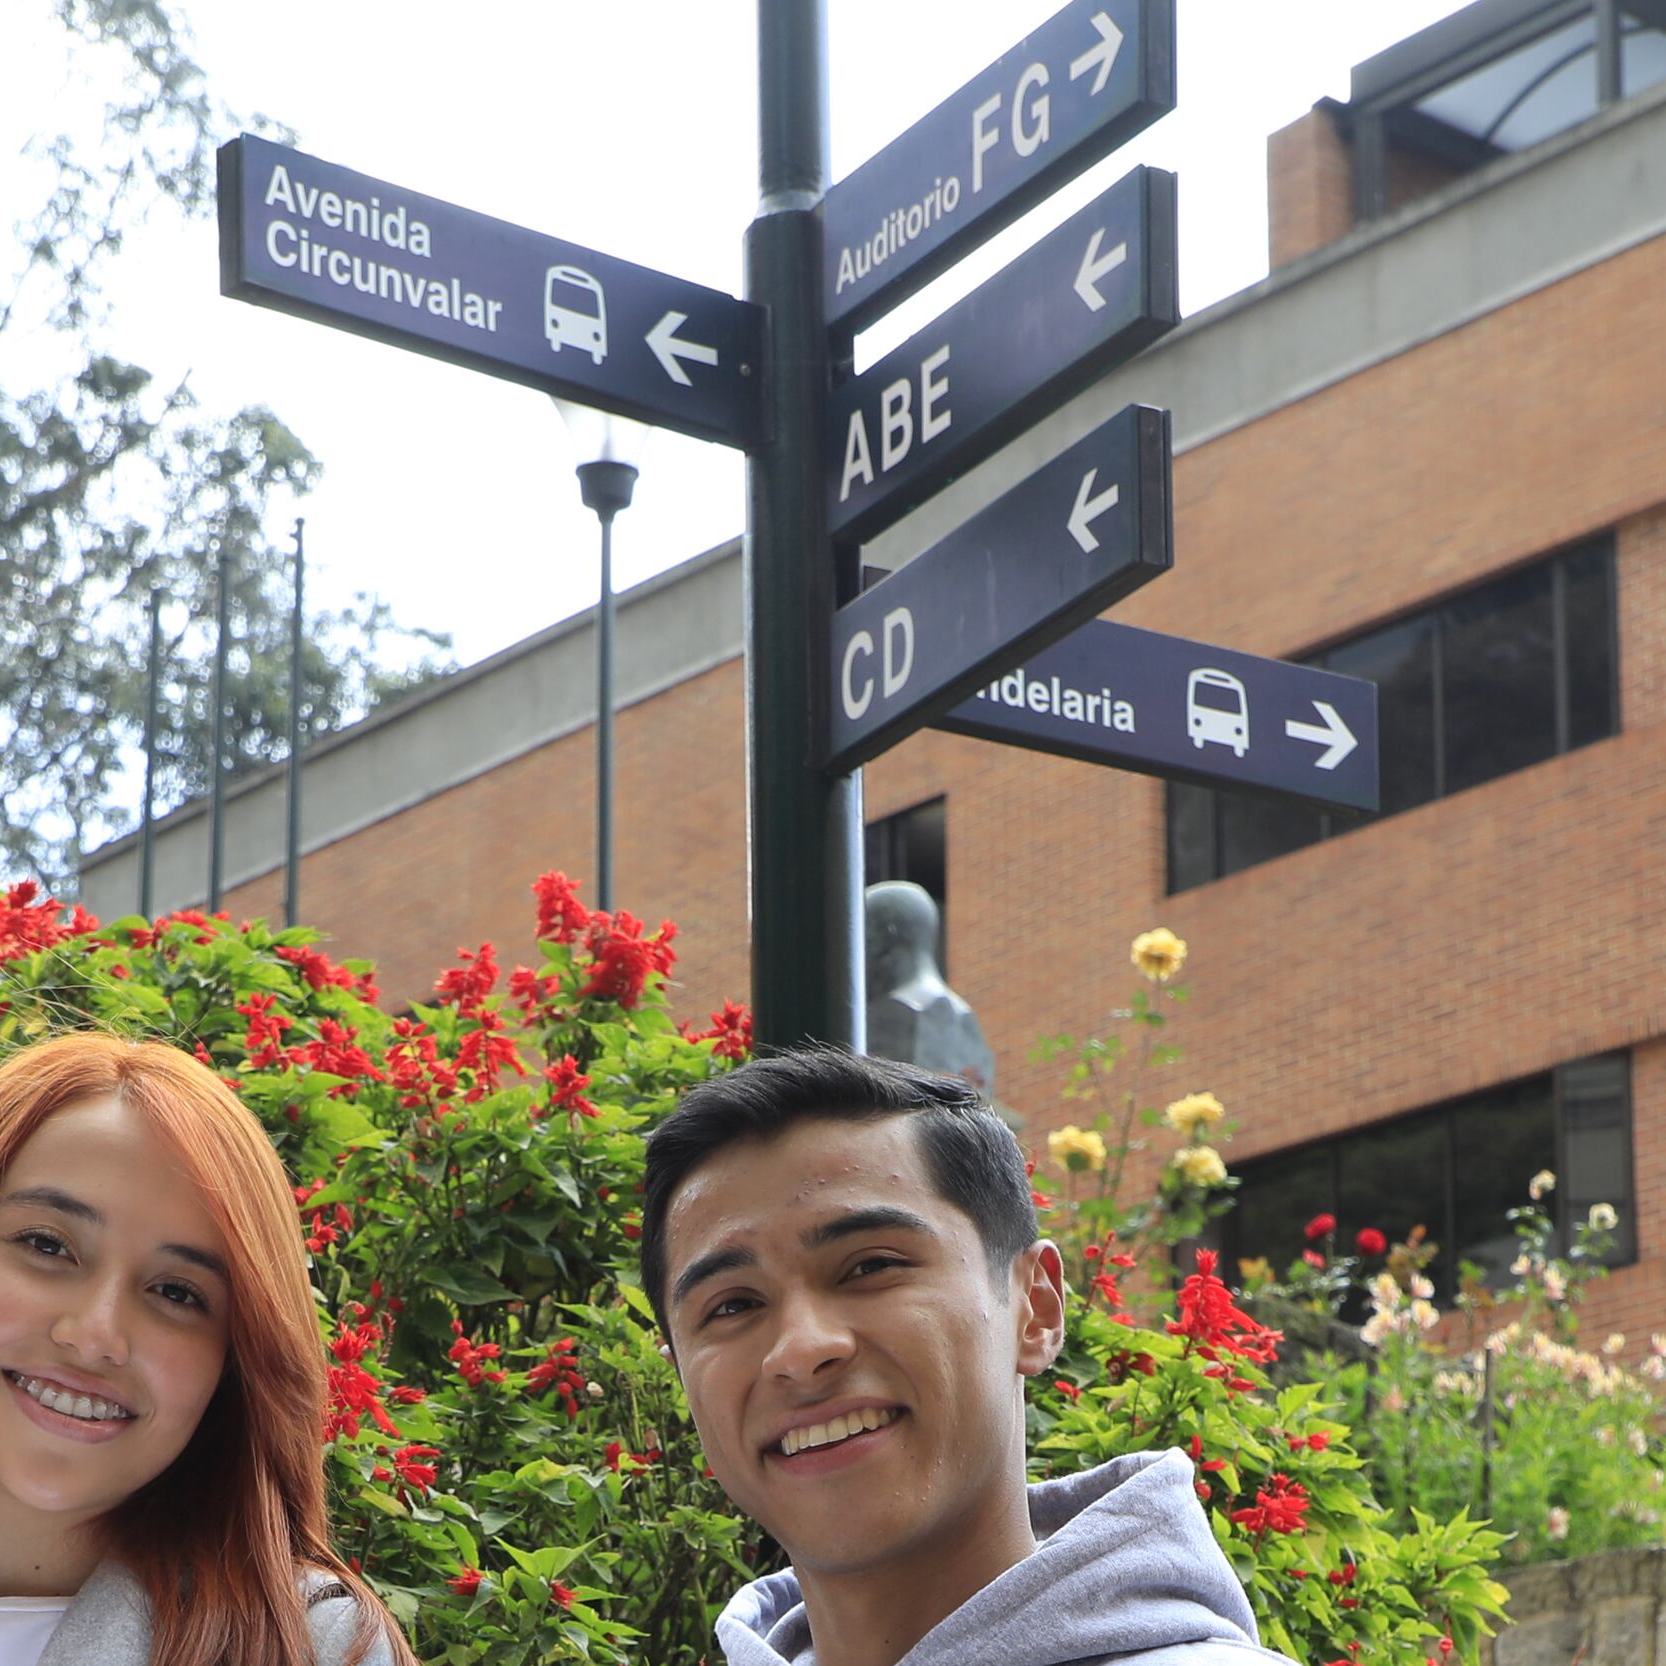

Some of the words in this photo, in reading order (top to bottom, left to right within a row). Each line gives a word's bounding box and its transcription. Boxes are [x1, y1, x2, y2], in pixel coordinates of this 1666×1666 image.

[264, 164, 432, 258] Avenida
[836, 176, 960, 295] Auditorio
[972, 62, 1050, 193] FG
[266, 220, 503, 332] Circunvalar
[839, 343, 952, 502] ABE
[842, 607, 915, 721] CD
